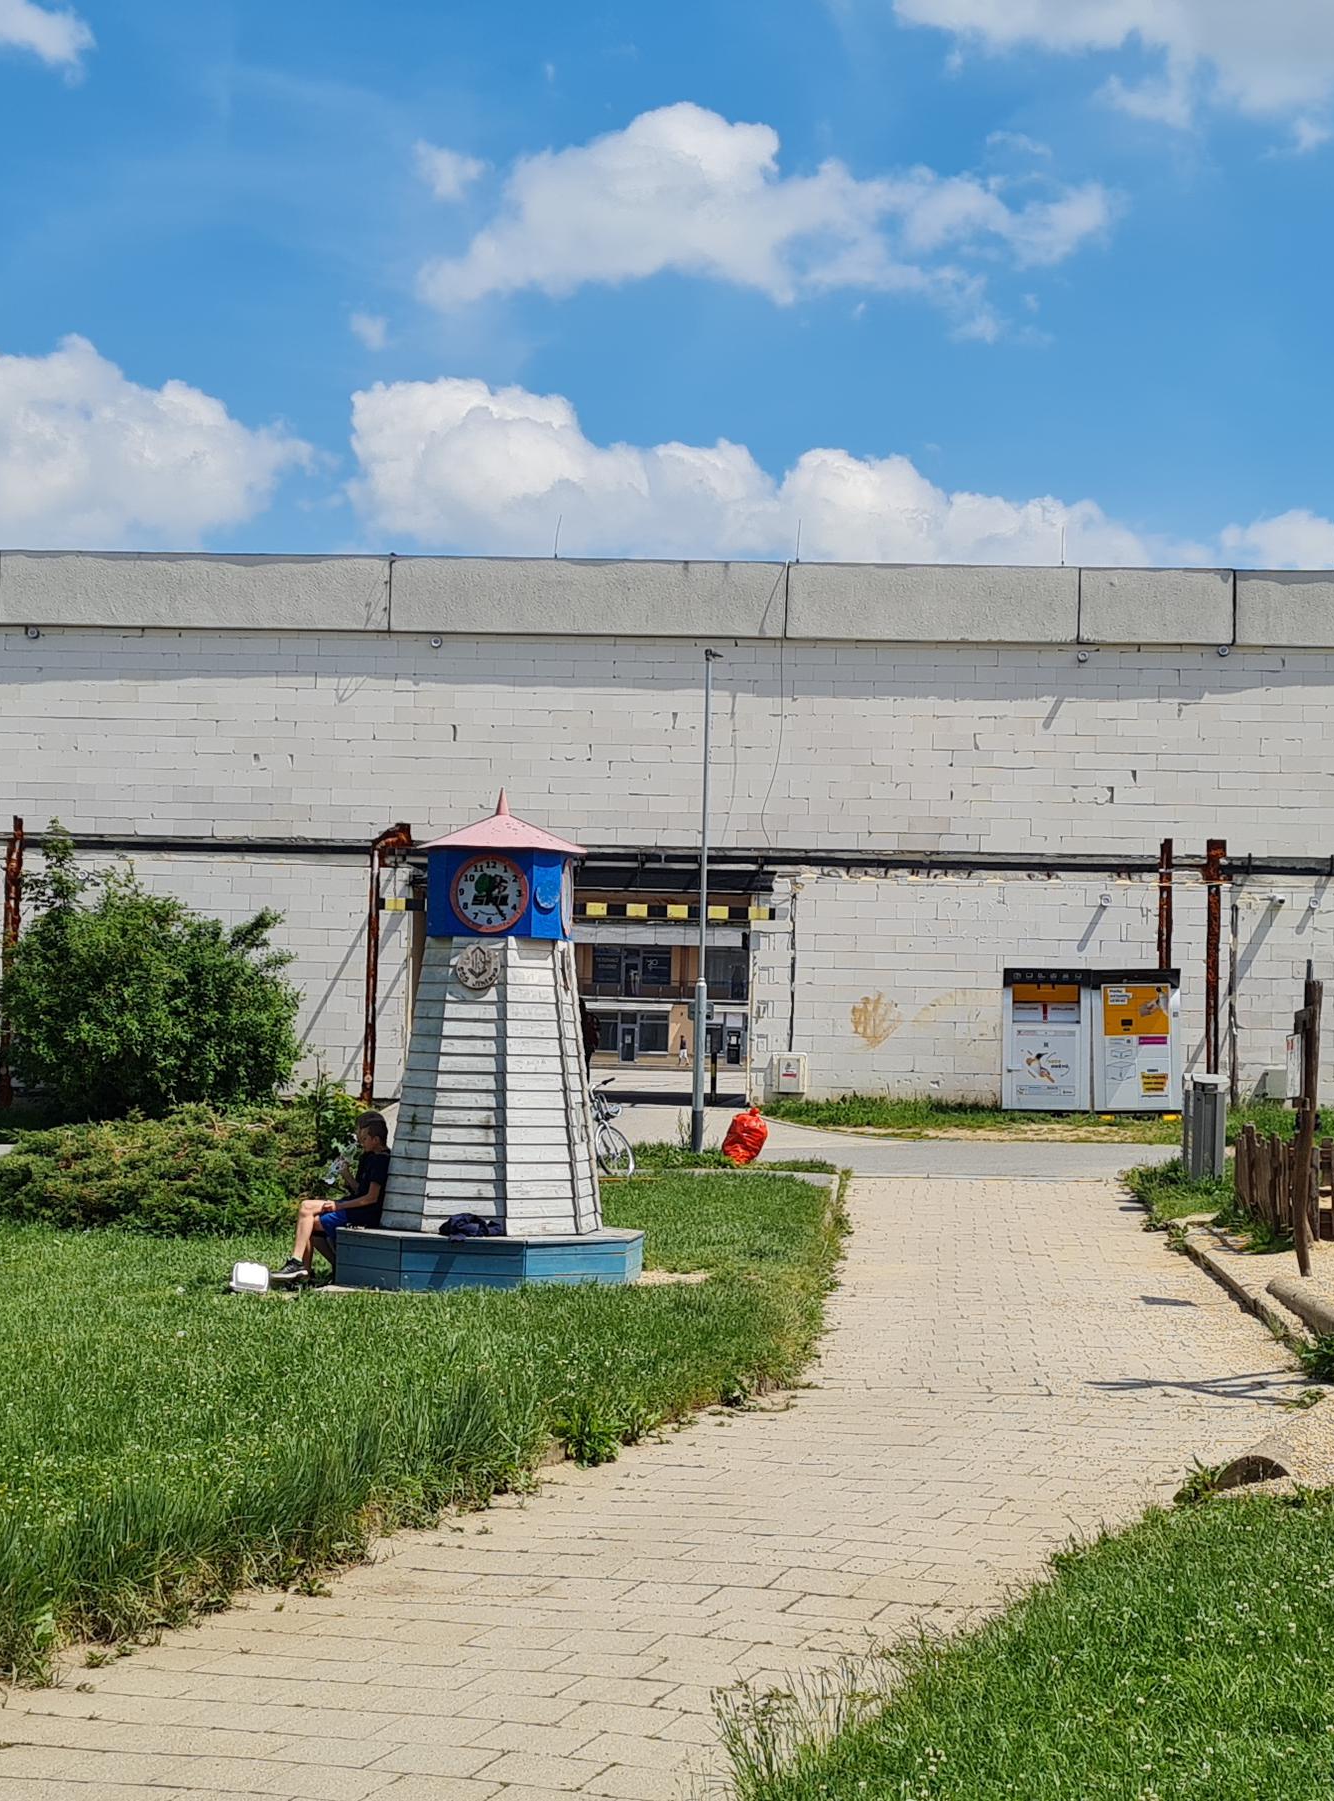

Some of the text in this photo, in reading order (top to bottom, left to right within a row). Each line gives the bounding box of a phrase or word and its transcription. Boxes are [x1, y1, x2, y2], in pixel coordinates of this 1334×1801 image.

[464, 874, 475, 882] 10
[459, 888, 464, 896] 9
[516, 889, 522, 897] 3
[462, 902, 468, 910] 8
[511, 903, 517, 911] 4
[473, 912, 479, 920] 7
[487, 917, 492, 925] 6
